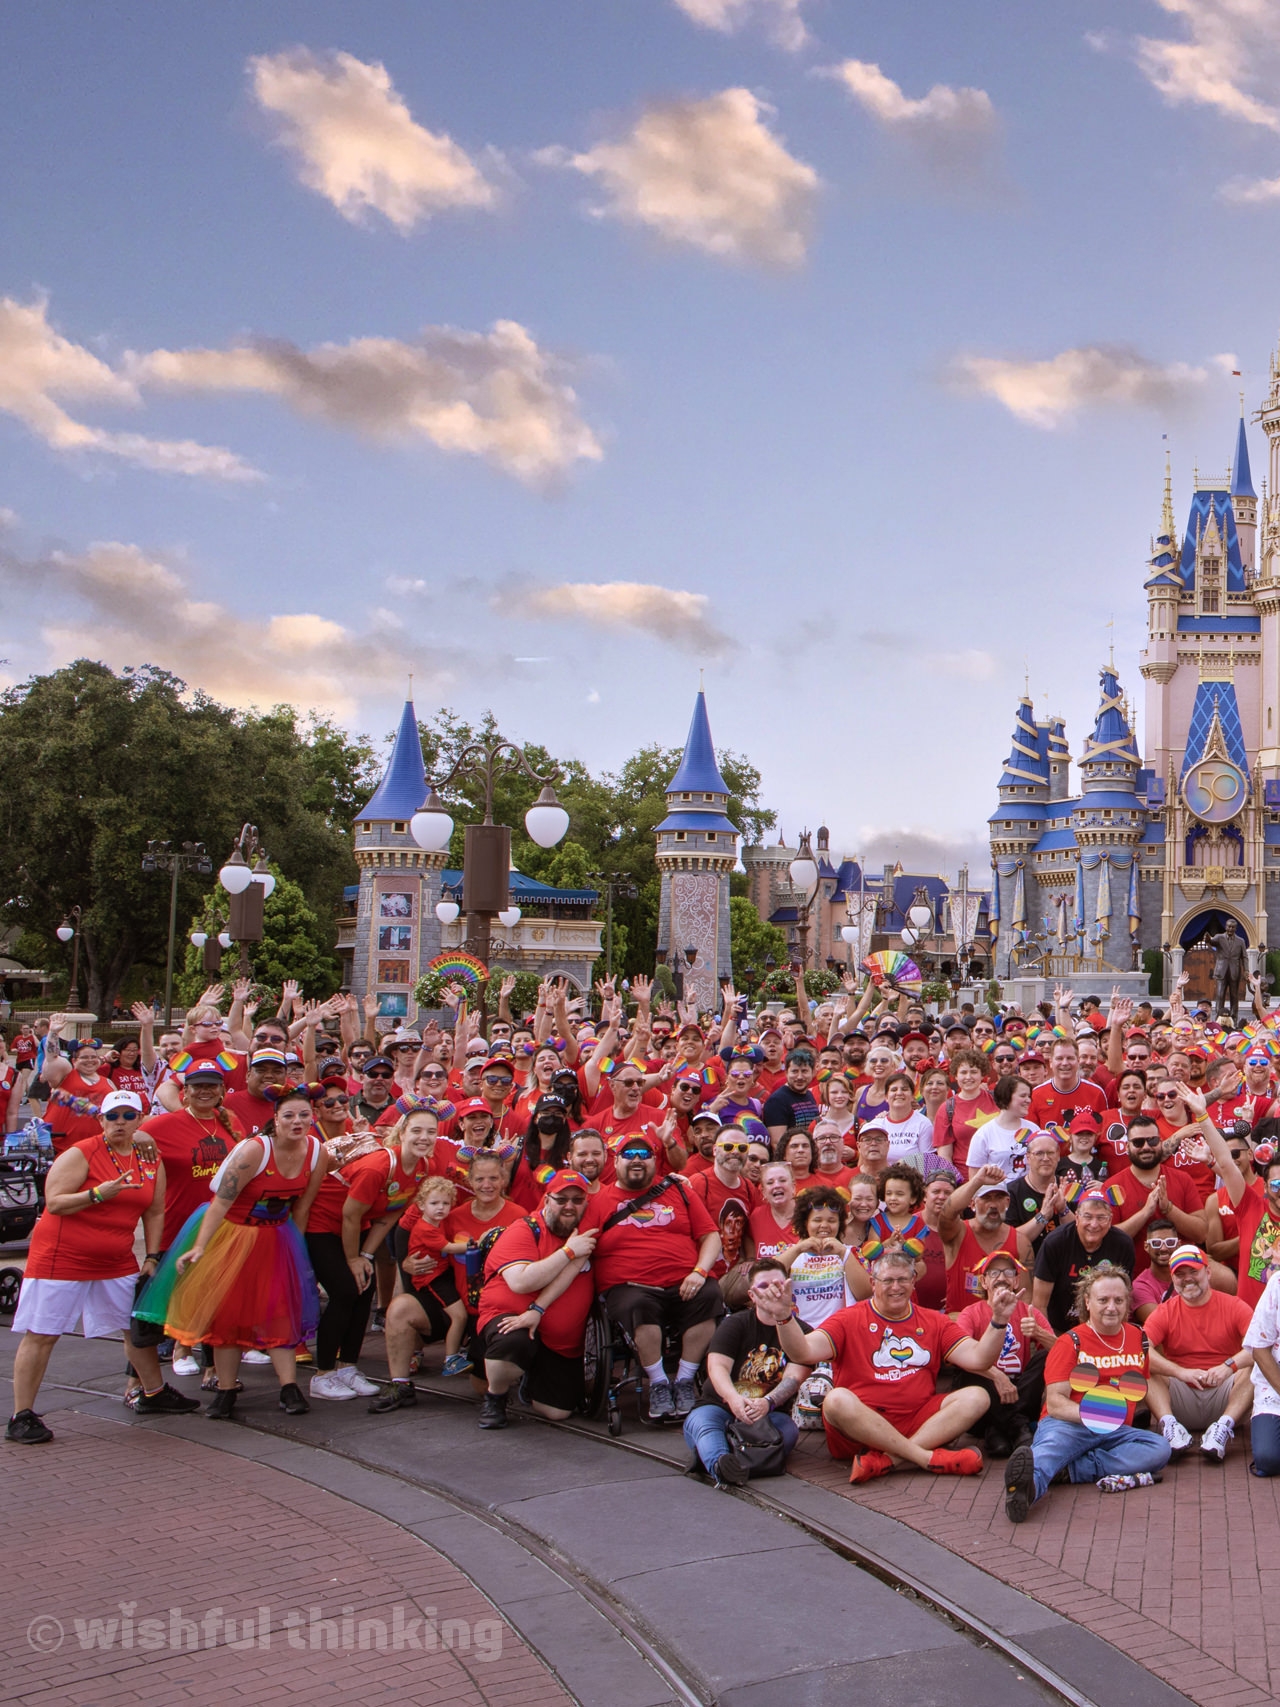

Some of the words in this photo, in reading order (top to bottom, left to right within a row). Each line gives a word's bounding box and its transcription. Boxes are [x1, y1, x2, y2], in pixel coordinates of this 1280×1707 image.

[1198, 771, 1239, 815] 50
[807, 1255, 840, 1264] MONDA
[803, 1260, 840, 1269] TUESDA
[794, 1284, 843, 1295] SATURDAY
[806, 1292, 844, 1301] SUNDAY
